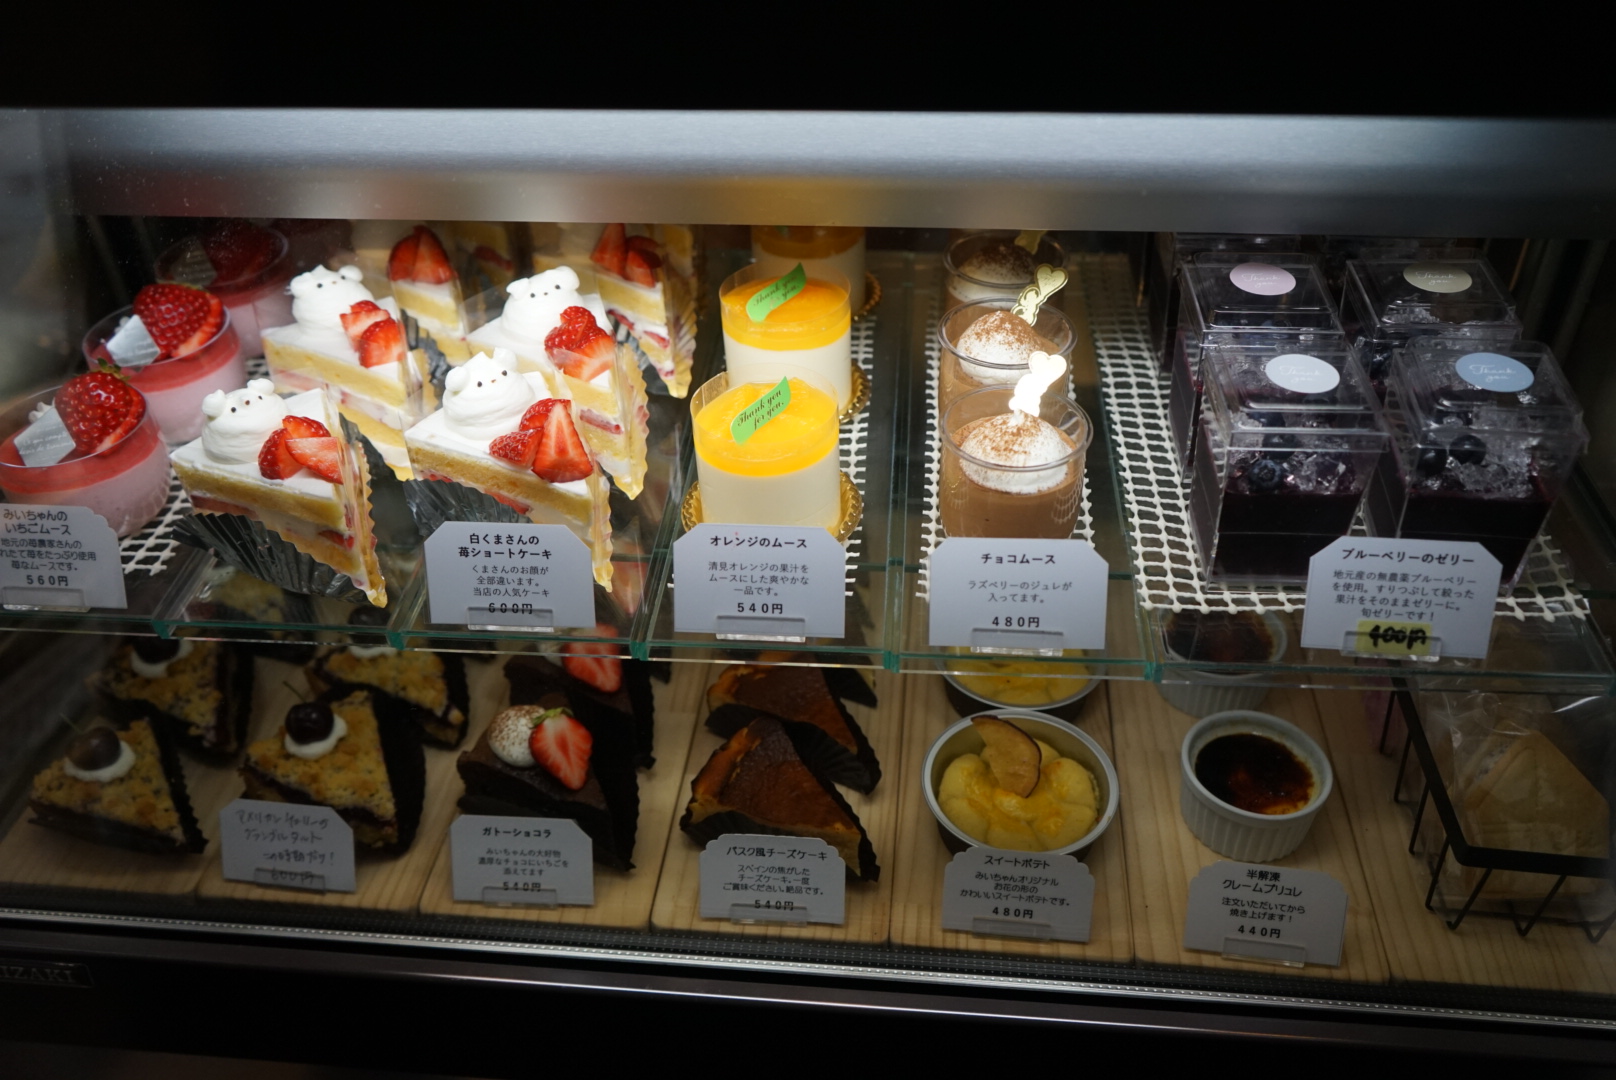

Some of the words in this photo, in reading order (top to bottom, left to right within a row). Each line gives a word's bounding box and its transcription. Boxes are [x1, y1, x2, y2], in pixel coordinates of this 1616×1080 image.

[737, 400, 765, 427] Thank
[767, 390, 782, 407] you
[754, 414, 766, 431] for
[3, 508, 68, 522] みいちゃんの
[5, 522, 72, 536] いちごムース
[469, 532, 540, 546] 白くまさんの
[710, 535, 808, 548] オレンジのムース
[458, 546, 552, 560] 苺ショートケーキ
[981, 553, 1056, 565] チョコムース
[1342, 548, 1475, 566] ブルーベリーのゼリー
[472, 564, 548, 576] くまさんのお顔が
[708, 561, 809, 574] 清見オレンジの果汁を
[26, 574, 68, 586] 560円
[476, 576, 540, 587] 全部違います。
[708, 573, 810, 586] ムースにした爽やかな
[1333, 569, 1476, 586] 地元産の無農薬ブルーベリー
[473, 587, 550, 598] 当店の人気ケーキ
[734, 586, 779, 597] 一品です。
[968, 580, 1072, 592] ラズベリーのジュレが
[988, 593, 1045, 604] 入ってます。
[1335, 594, 1461, 612] 果汁をそのままゼリーに。
[488, 602, 533, 615] 600円
[737, 602, 783, 614] 540円
[992, 616, 1040, 628] 480円
[482, 827, 552, 838] ガトーショコラ
[486, 848, 562, 858] みいちゃんの大好物
[726, 846, 828, 861] バスク風チーズケーキ
[984, 855, 1050, 869] スイートポテト
[737, 864, 810, 876] スペインの焦がした
[1246, 869, 1281, 882] 半解凍
[974, 871, 1059, 887] みいちゃんオリジナル
[503, 881, 542, 892] 540円
[994, 882, 1038, 894] お花の形の
[754, 900, 794, 912] 540円
[1221, 896, 1306, 914] 注文いただいてから
[992, 906, 1034, 919] 480円
[1229, 908, 1292, 923] 焼き上げます！
[1238, 925, 1281, 939] 440円
[0, 965, 77, 984] IZAKI
